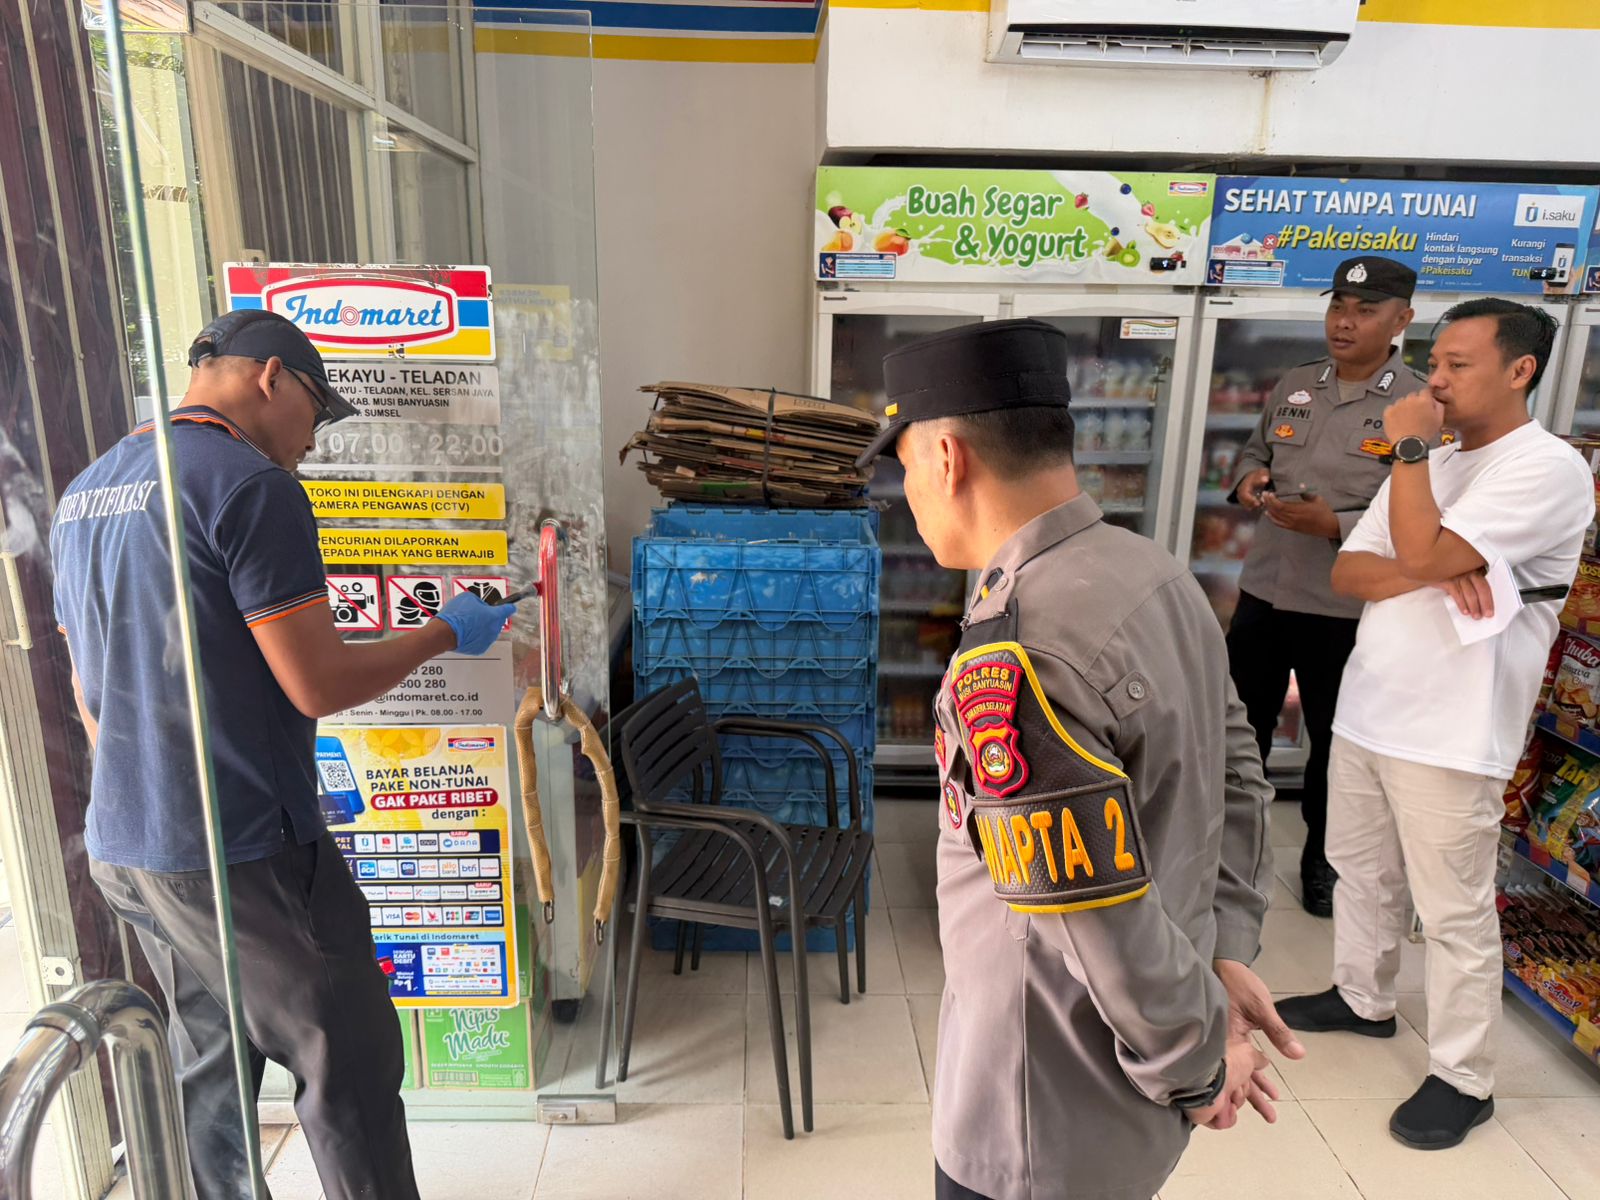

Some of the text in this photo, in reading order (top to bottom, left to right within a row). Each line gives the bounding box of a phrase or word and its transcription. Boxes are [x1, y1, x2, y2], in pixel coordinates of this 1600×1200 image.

[908, 186, 1062, 226] Buah Segar
[1224, 188, 1477, 218] SEHAT TANPA TUNAI
[1542, 209, 1576, 222] i.saku
[1276, 224, 1418, 251] #Pakeisaku
[1425, 232, 1460, 242] Hindari
[954, 224, 1086, 268] & Yogurt
[1424, 243, 1499, 256] kontak langsung
[1511, 239, 1546, 250] Kurangi
[1422, 255, 1483, 266] dengan bayar
[1501, 254, 1543, 264] transaksi
[1512, 268, 1530, 278] TUN
[285, 295, 443, 327] Indomaret
[400, 370, 481, 385] TELADAN
[364, 387, 408, 396] TELADAN,
[411, 387, 431, 396] KEL.
[433, 388, 470, 397] SERSAN
[472, 389, 494, 397] JAYA
[373, 398, 396, 406] MUSI
[398, 399, 450, 407] BANYUASIN
[364, 409, 401, 417] SUMSEL
[309, 488, 486, 499] TOKO INI DILENGKAPI DENGAN
[310, 501, 470, 513] KAMERA PENGAWAS (CCTV)
[317, 536, 459, 546] ENCURIAN DILAPORKAN
[319, 548, 495, 558] EPADA PIHAK YANG BERWAJIB
[421, 666, 443, 675] 280
[424, 679, 446, 688] 280
[957, 667, 1010, 692] POLRES
[972, 679, 1012, 693] BANYUASIN
[366, 764, 475, 780] BAYAR BELANJA
[371, 775, 489, 792] PAKE NON-TUNAI
[375, 790, 494, 808] GAK PAKE RIBET
[431, 809, 479, 820] dengan
[1104, 796, 1135, 872] 2
[451, 1008, 499, 1031] Nipis
[444, 1027, 509, 1060] Madu
